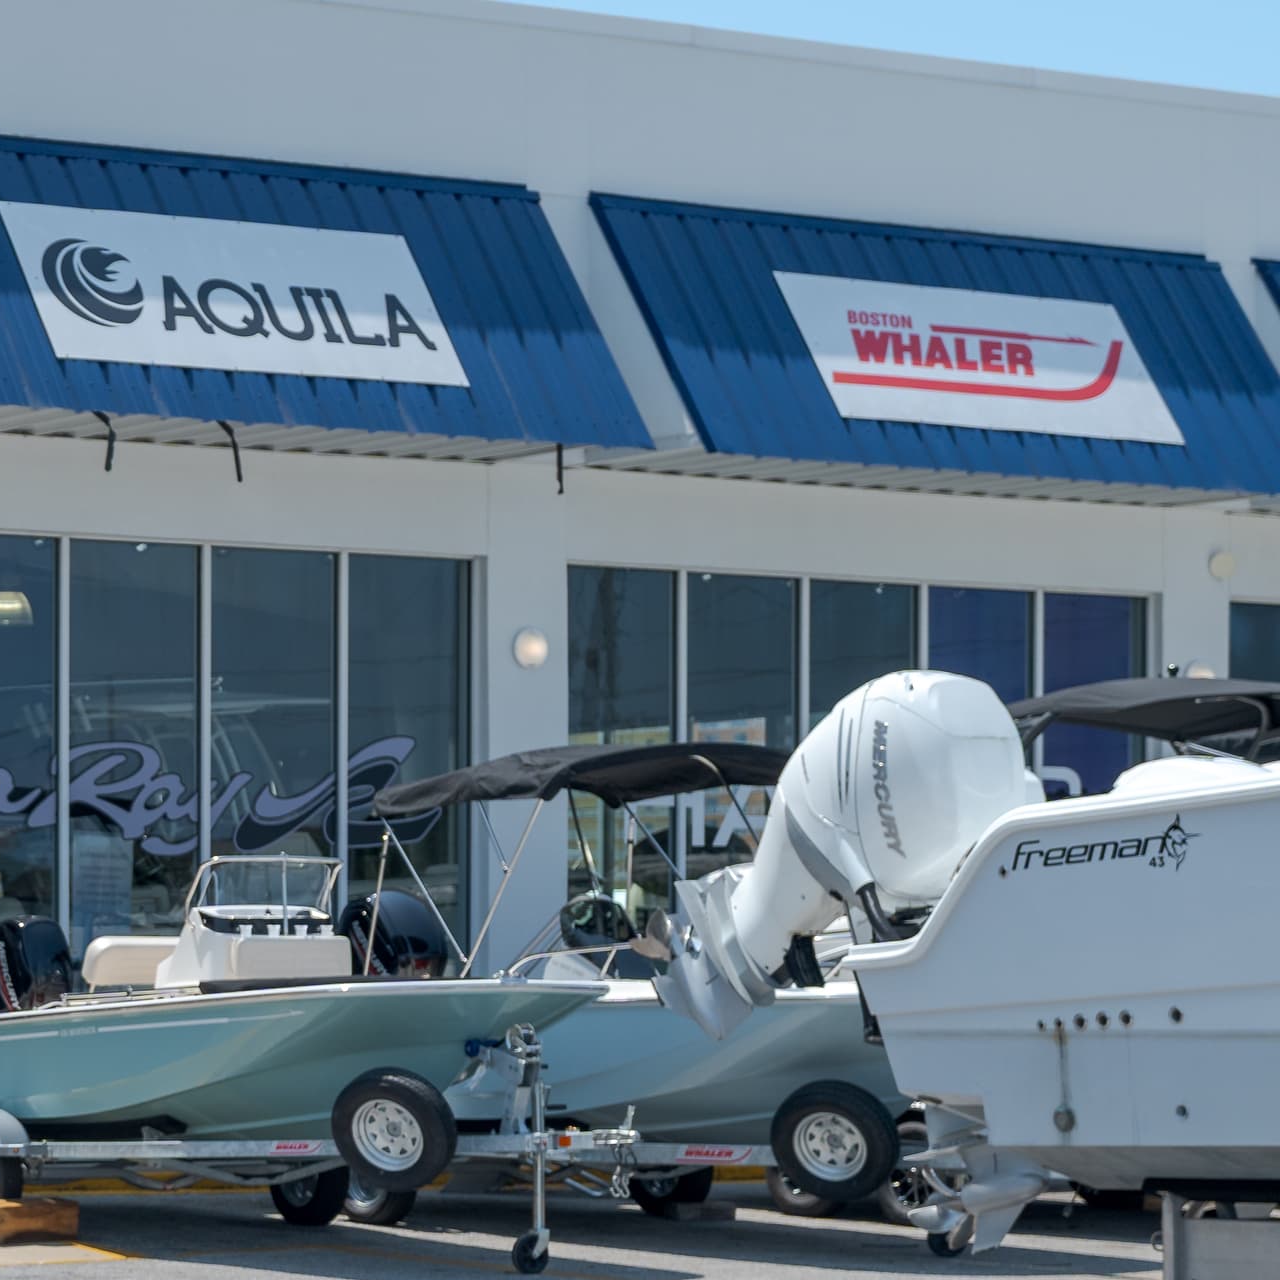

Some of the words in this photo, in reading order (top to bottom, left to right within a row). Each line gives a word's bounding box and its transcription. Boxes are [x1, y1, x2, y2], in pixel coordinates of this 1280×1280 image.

[162, 275, 437, 350] AQUILA
[847, 310, 913, 329] BOSTON
[851, 328, 1034, 376] WHALER
[26, 740, 255, 857] Ray
[872, 720, 907, 859] MERCURY
[1012, 834, 1166, 871] freeman
[1149, 857, 1165, 868] 43
